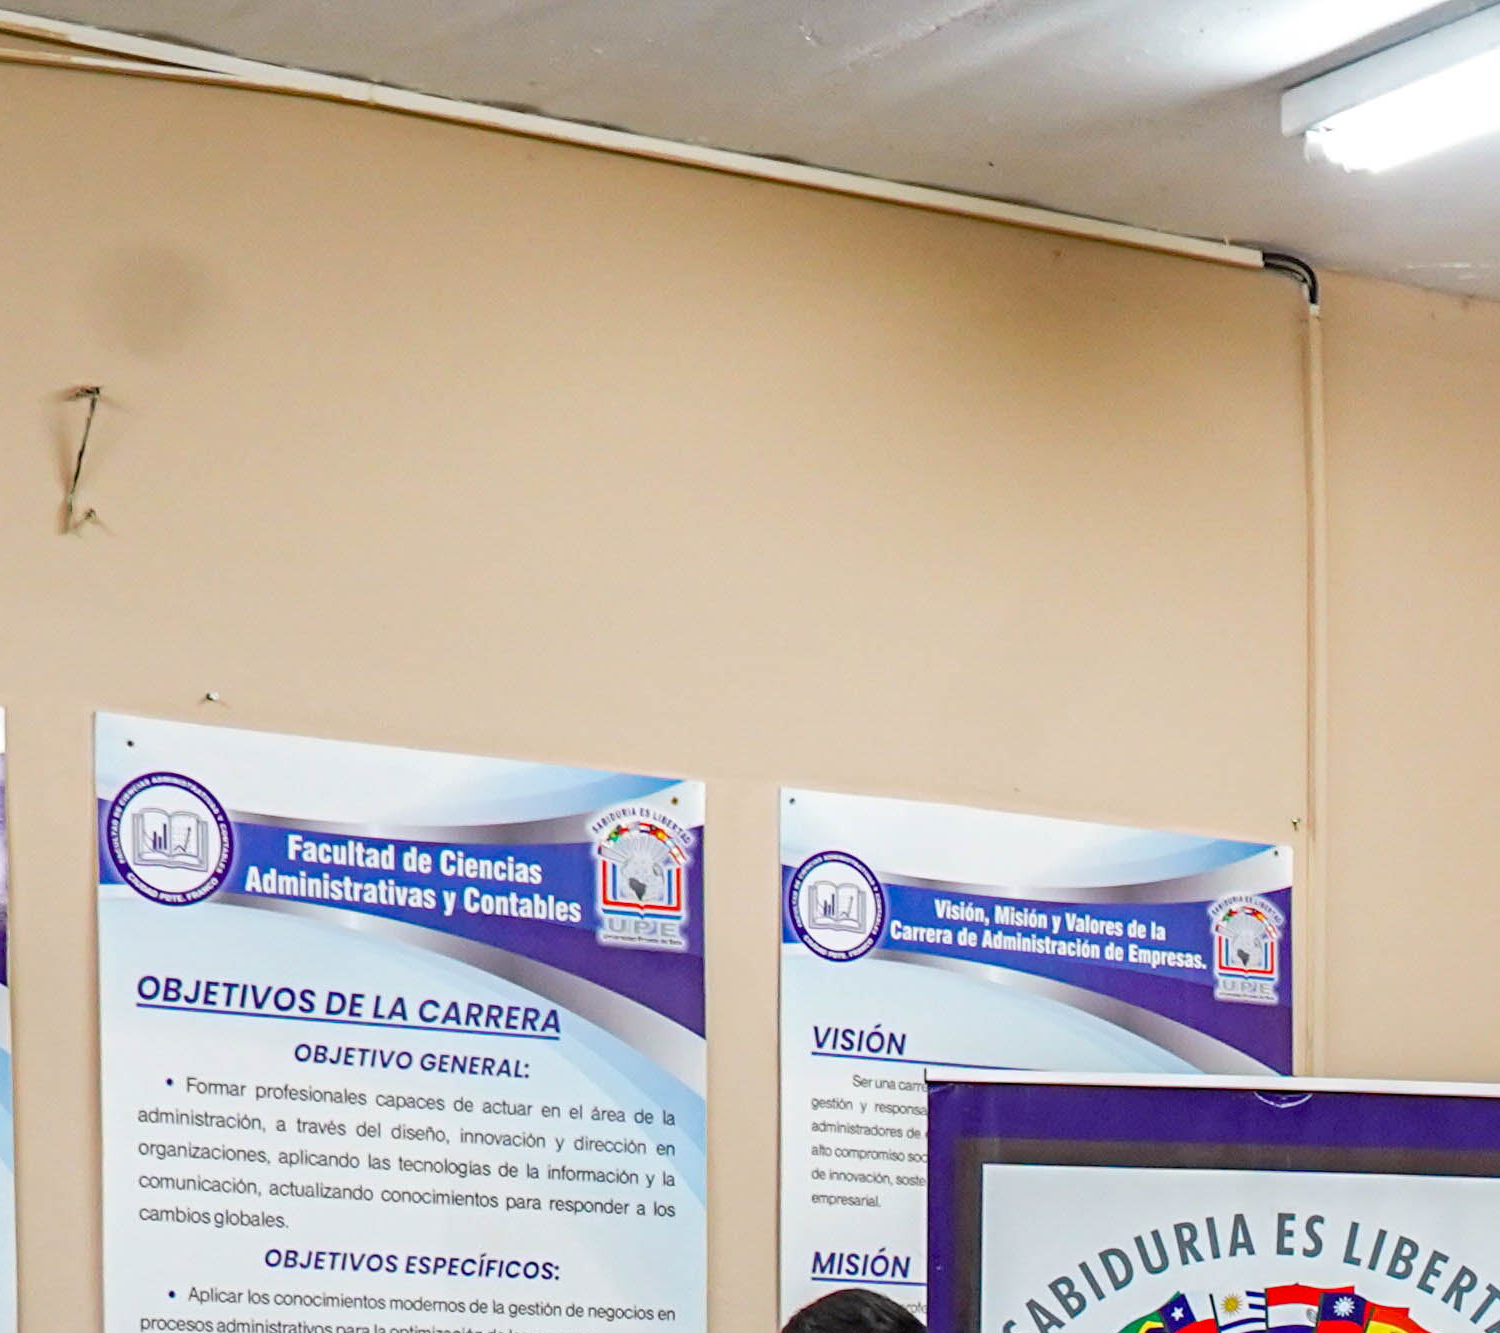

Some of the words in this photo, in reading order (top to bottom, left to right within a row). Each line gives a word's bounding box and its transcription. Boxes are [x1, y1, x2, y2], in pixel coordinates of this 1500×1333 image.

[287, 834, 395, 870] Facultad
[402, 845, 432, 875] de
[439, 849, 542, 885] Ciencias
[244, 865, 436, 909] Administrativas
[442, 890, 457, 917] y
[463, 886, 581, 923] Contables
[934, 898, 990, 926] Visión,
[994, 903, 1048, 930] Misión
[1051, 914, 1061, 935] y
[1064, 912, 1123, 937] Valores
[1127, 919, 1146, 939] de
[1150, 921, 1166, 941] la
[889, 919, 953, 945] Carrera
[957, 926, 977, 947] de
[981, 929, 1100, 959] Administración
[1104, 941, 1124, 962] de
[1128, 943, 1207, 969] Empresas.
[137, 975, 316, 1013] OBJETIVOS
[325, 991, 365, 1018] DE
[372, 994, 407, 1021] LA
[418, 999, 560, 1033] CARRERA
[294, 1043, 412, 1070] OBJETIVO
[420, 1052, 529, 1078] GENERAL:
[813, 1023, 906, 1055] VISIÓN
[186, 1076, 246, 1096] Formar
[255, 1083, 367, 1106] profesionales
[375, 1093, 445, 1111] capaces
[453, 1095, 473, 1113] de
[481, 1099, 532, 1116] actuar
[540, 1105, 560, 1118] en
[568, 1104, 582, 1120] el
[590, 1105, 626, 1123] área
[633, 1108, 654, 1125] de
[662, 1109, 675, 1126] la
[1276, 1211, 1324, 1258] ES
[264, 1248, 398, 1273] OBJETIVOS
[405, 1252, 560, 1280] ESPECÍFICOS:
[811, 1247, 910, 1278] MISIÓN
